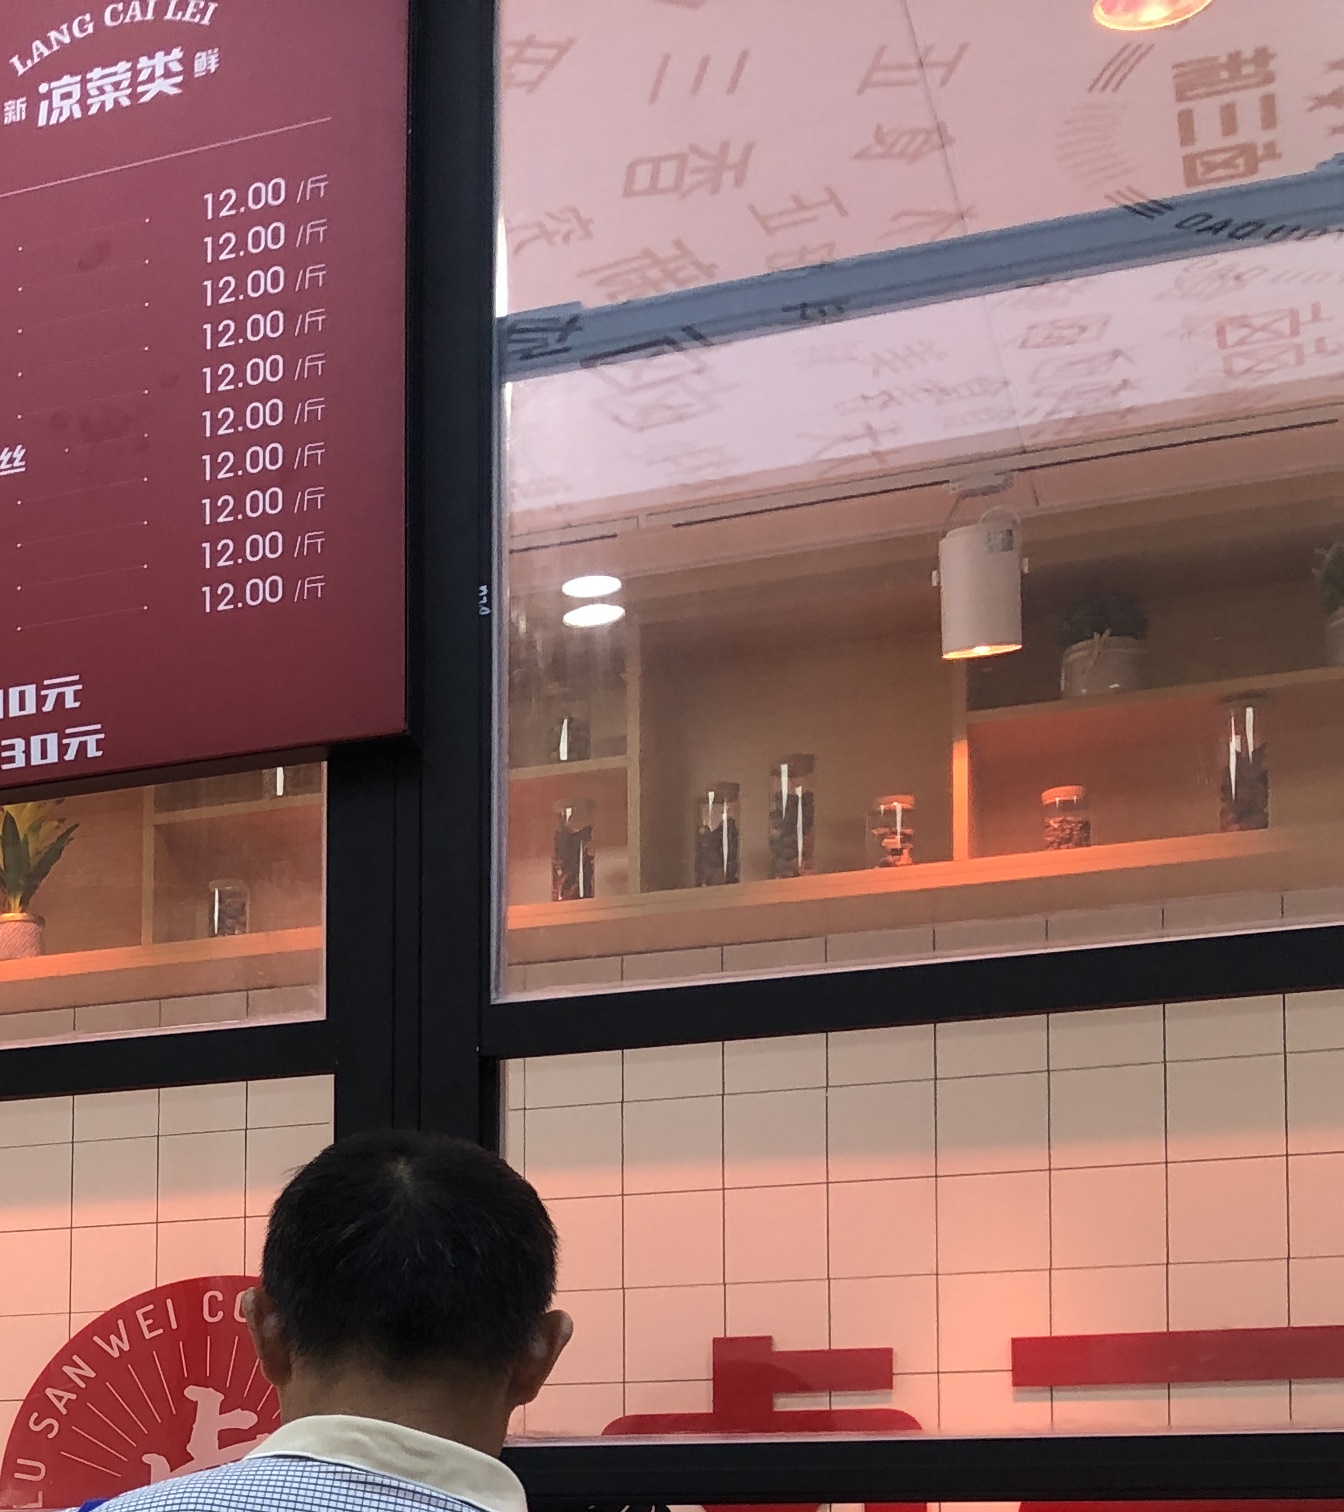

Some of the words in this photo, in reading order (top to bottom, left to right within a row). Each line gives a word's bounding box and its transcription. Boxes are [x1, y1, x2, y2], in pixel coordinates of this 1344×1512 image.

[9, 13, 95, 77] LANG
[103, 0, 157, 27] CAI
[163, 0, 219, 27] LEI
[3, 96, 28, 126] 新
[37, 45, 185, 128] 凉菜类
[194, 47, 221, 79] 鲜
[28, 1354, 96, 1439] SAN
[92, 1298, 178, 1358] WEI
